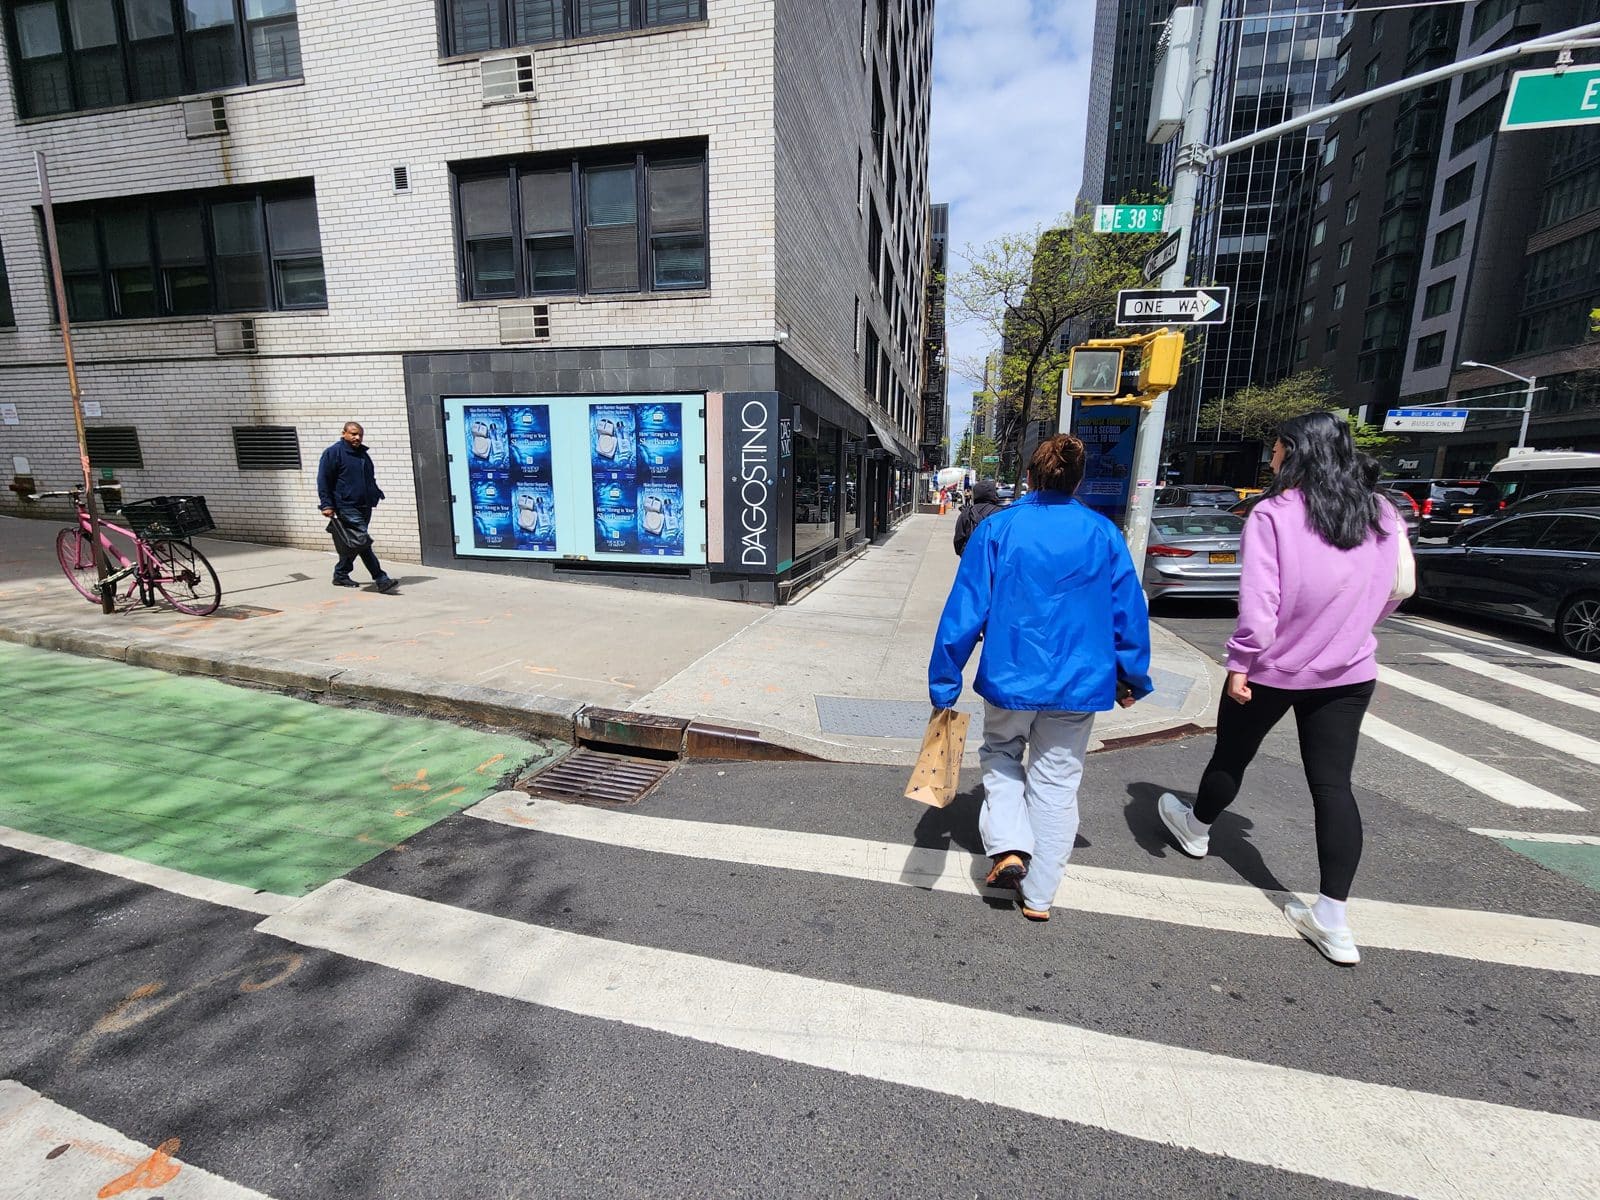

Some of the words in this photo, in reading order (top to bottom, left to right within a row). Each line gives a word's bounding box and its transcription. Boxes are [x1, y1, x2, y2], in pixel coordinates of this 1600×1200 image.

[1580, 78, 1600, 110] E
[1113, 209, 1124, 228] E
[1127, 209, 1147, 228] 38
[1152, 209, 1163, 222] St
[1134, 300, 1164, 314] ONE
[1178, 300, 1210, 312] WAY
[780, 422, 790, 440] DAG
[1099, 426, 1120, 434] SECOND
[780, 438, 791, 455] NYC
